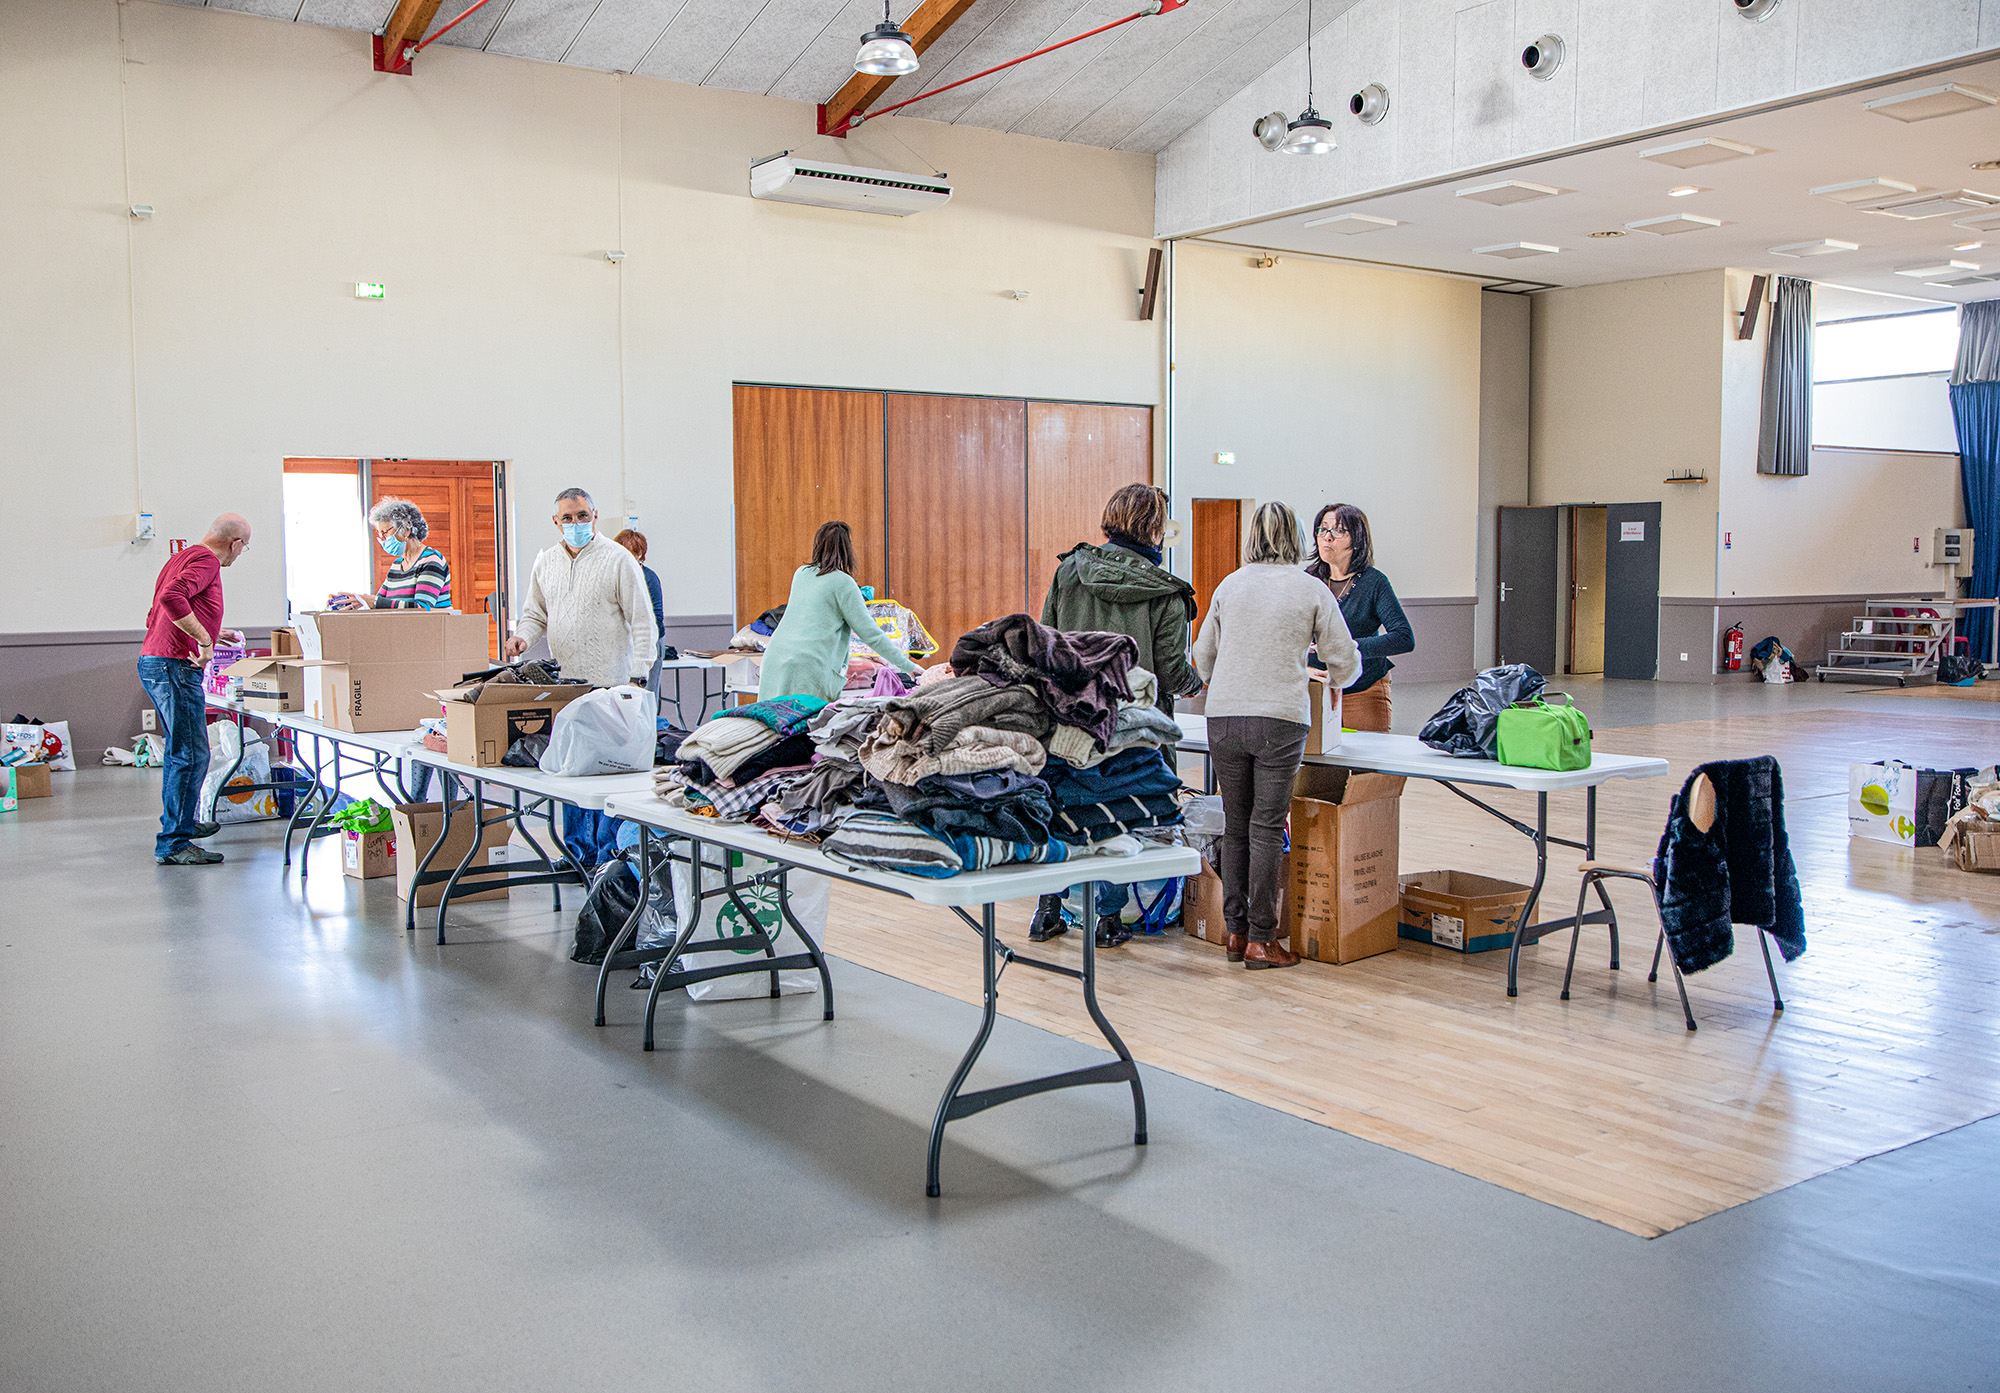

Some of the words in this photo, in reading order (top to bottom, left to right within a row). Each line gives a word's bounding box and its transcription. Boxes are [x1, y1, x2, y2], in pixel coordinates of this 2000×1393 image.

[251, 681, 267, 690] FRAGILE
[354, 680, 362, 717] FRAGILE
[1354, 896, 1369, 905] FRANCE
